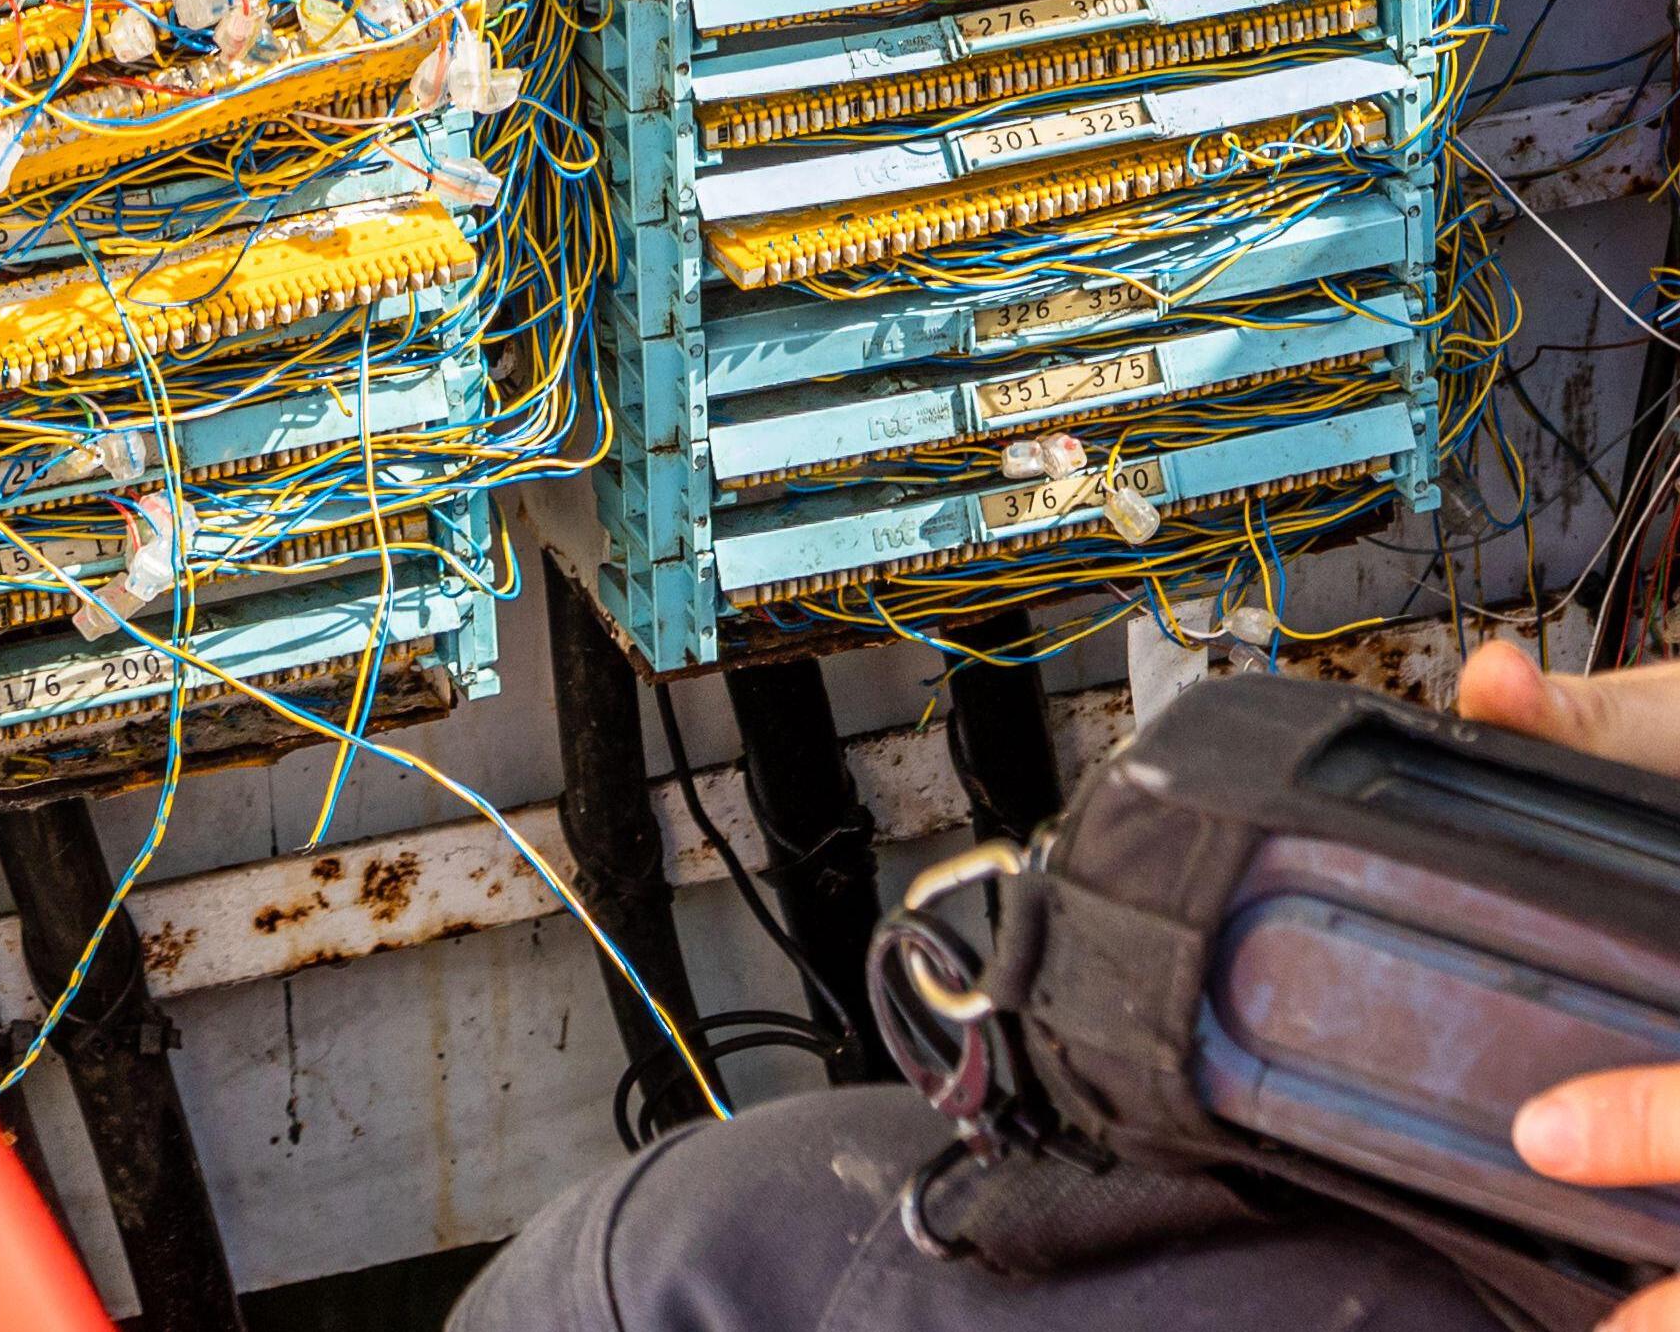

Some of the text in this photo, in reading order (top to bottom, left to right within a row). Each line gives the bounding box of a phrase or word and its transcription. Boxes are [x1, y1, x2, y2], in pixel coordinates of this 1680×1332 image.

[978, 9, 1035, 37] 276
[986, 127, 1041, 155] 301
[1080, 109, 1135, 137] 325
[998, 300, 1050, 326] 326
[998, 377, 1050, 406] 351
[1091, 357, 1145, 387] 375
[1005, 489, 1057, 517] 376
[4, 674, 61, 707] 176
[102, 654, 161, 688] 200
